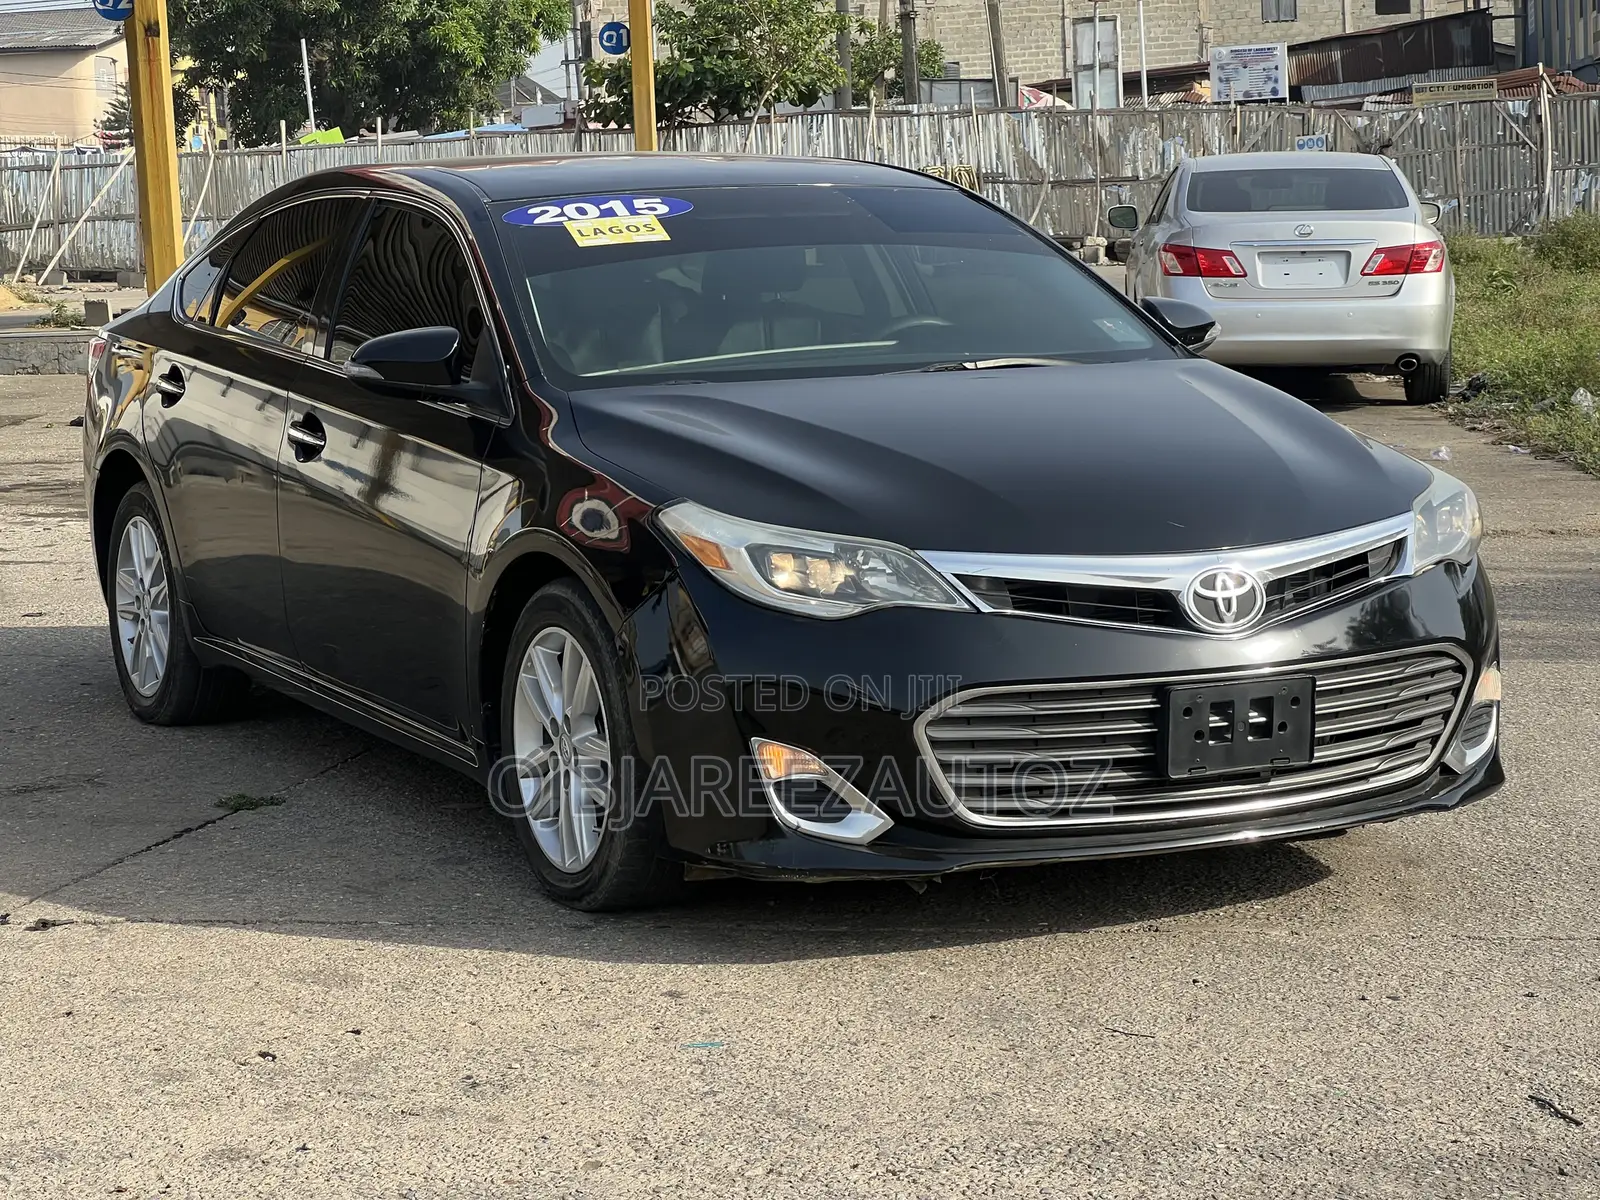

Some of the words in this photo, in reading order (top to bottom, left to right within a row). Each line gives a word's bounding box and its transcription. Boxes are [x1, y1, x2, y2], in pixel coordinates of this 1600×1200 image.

[602, 28, 628, 47] Q1
[527, 198, 670, 224] 2015
[577, 223, 657, 238] LAGOS
